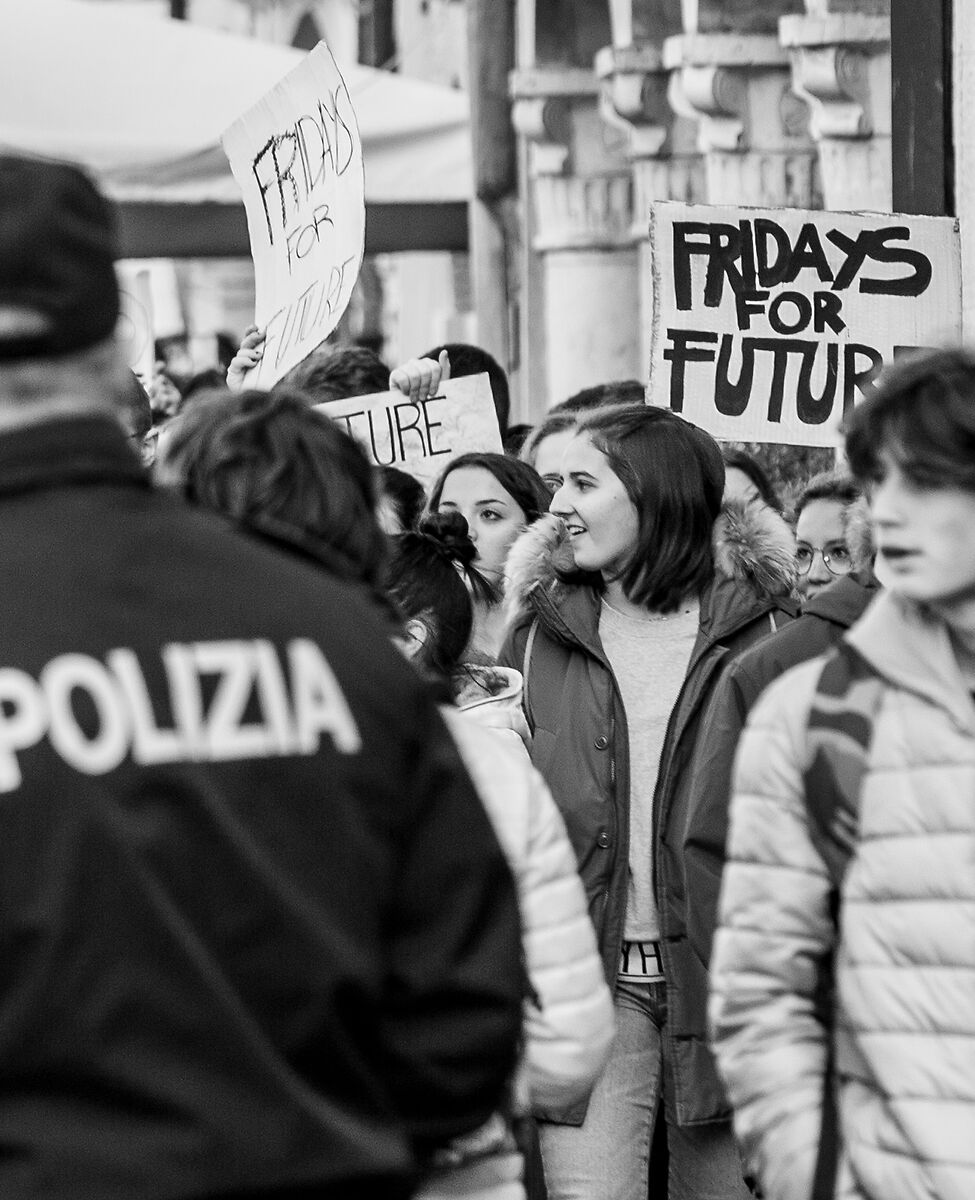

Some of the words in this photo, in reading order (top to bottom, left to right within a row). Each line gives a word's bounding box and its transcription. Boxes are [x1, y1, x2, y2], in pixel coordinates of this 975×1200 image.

[286, 204, 335, 276] FOR
[672, 218, 933, 311] FRIDAYS
[735, 290, 847, 335] FOR
[663, 327, 920, 425] FUTUR
